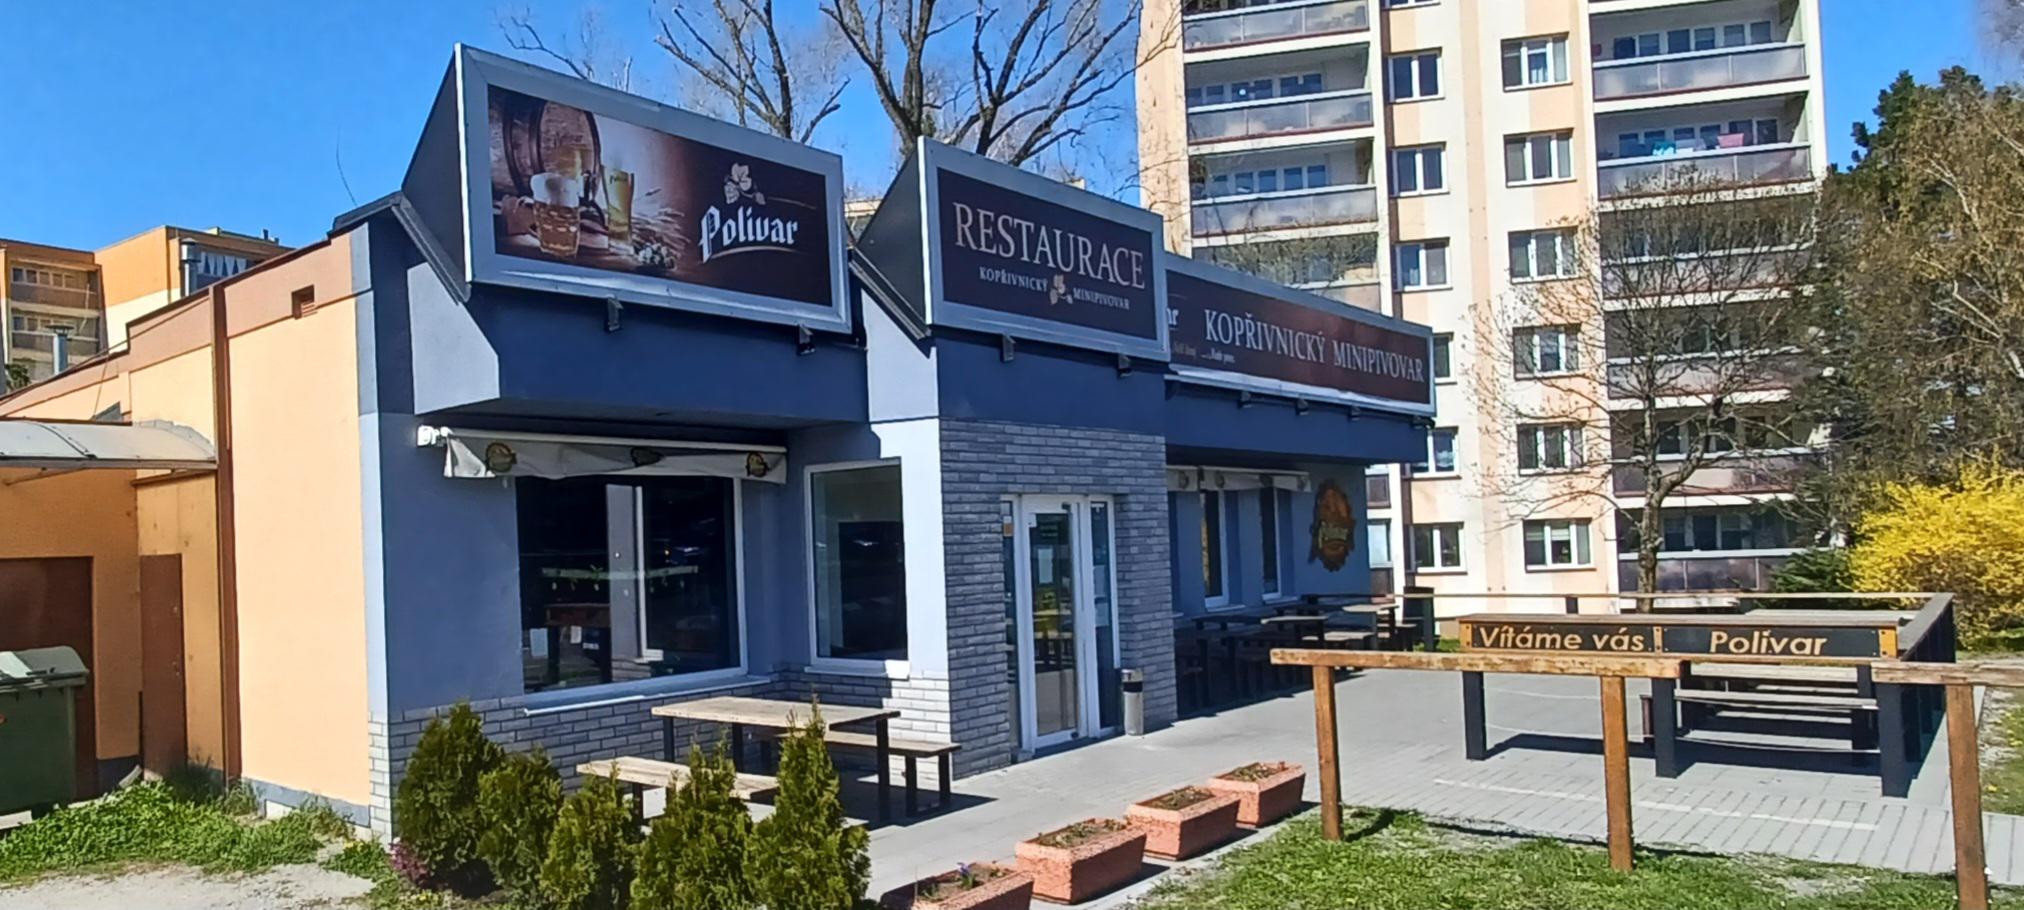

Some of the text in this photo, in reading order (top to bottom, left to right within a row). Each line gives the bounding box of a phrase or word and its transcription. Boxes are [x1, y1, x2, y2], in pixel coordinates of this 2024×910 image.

[953, 202, 1145, 289] RESTAURACE
[979, 266, 1130, 310] KOPŘIVNICKÝ MINIPIVOVAR
[1204, 309, 1325, 363] KOPŘIVNICKÝ
[1332, 340, 1424, 382] MINIPIVOVAR
[1479, 625, 1582, 650] Vítáme
[1592, 627, 1645, 651] vás
